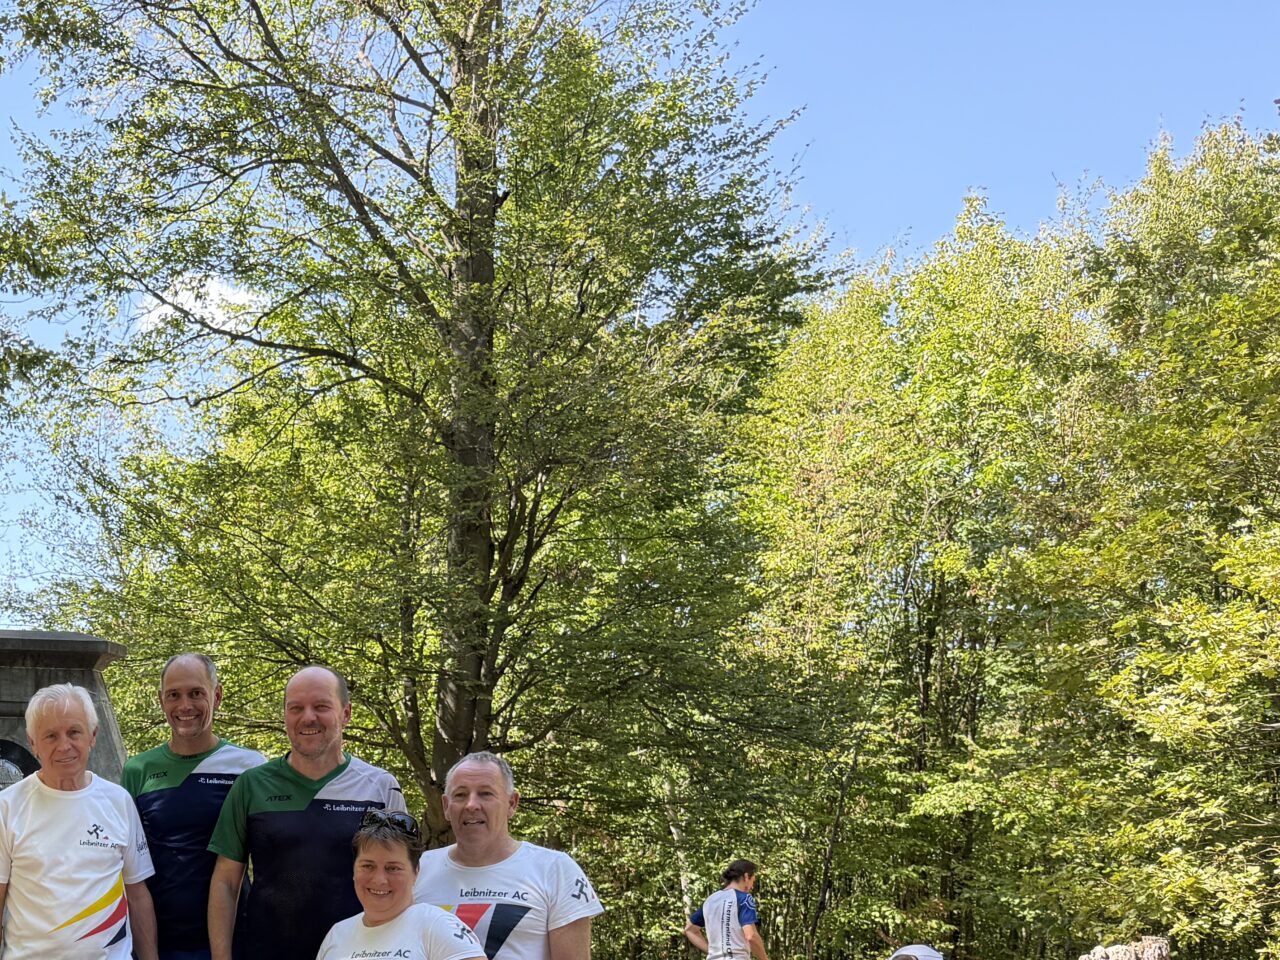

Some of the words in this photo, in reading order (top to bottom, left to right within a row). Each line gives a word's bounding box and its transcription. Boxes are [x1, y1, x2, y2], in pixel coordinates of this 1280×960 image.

[332, 804, 365, 812] Leibnitzer
[79, 839, 109, 848] Leibnitzer
[459, 888, 508, 898] Leibnitzer
[511, 889, 529, 901] AC
[351, 949, 392, 959] Leibnitzer
[394, 949, 411, 959] AC
